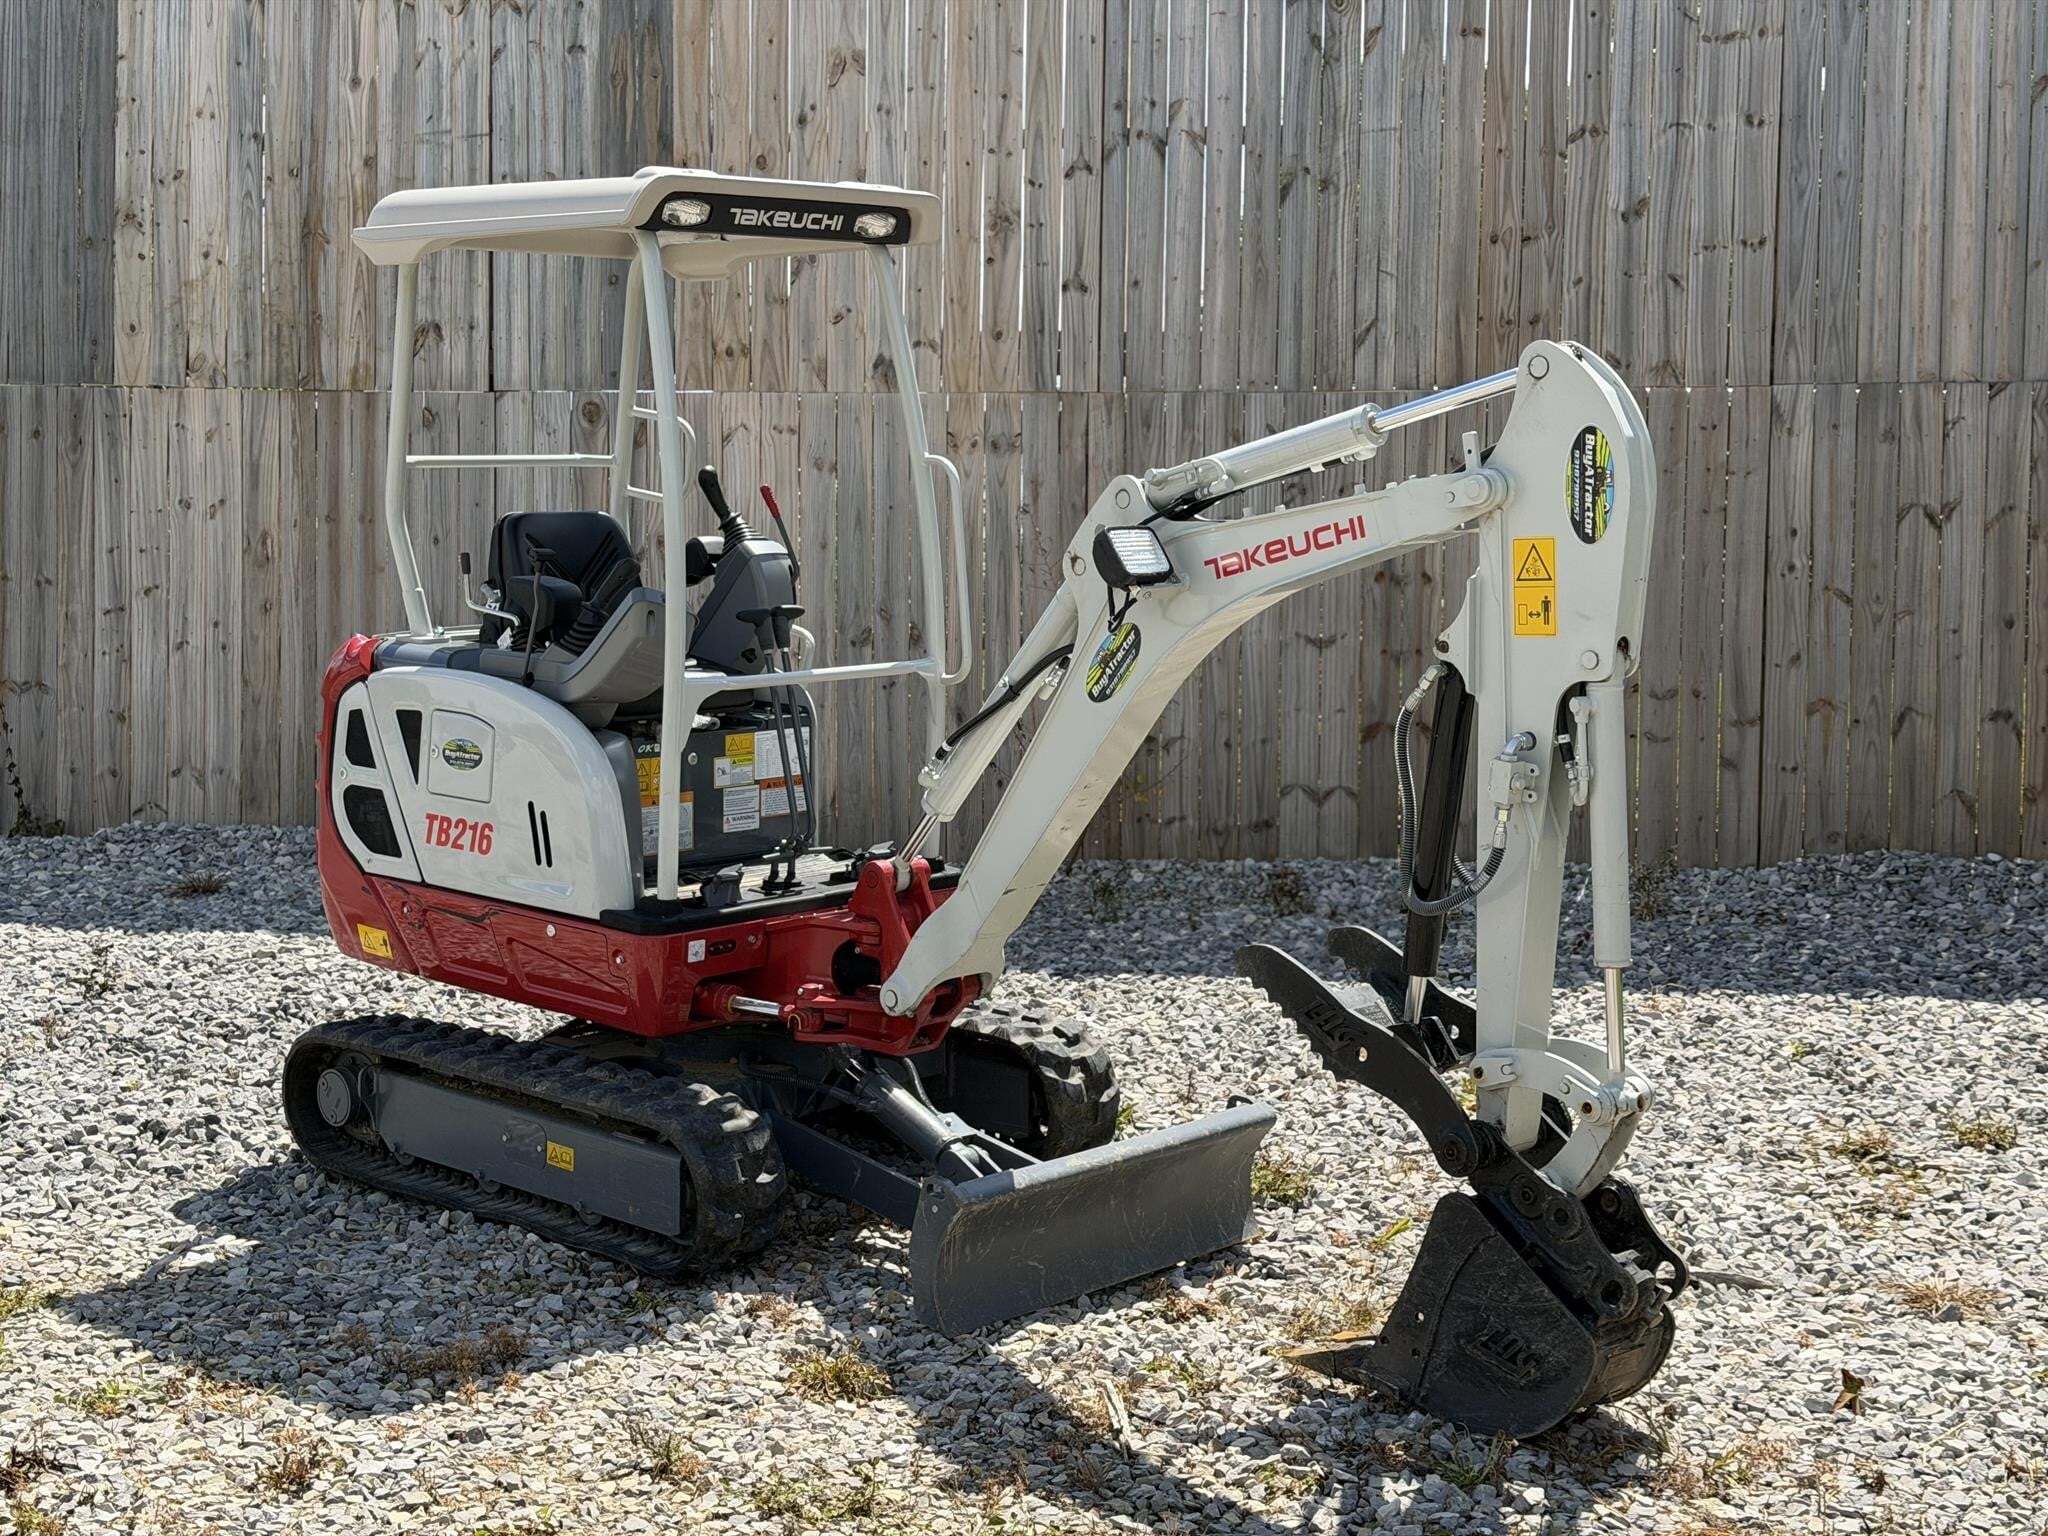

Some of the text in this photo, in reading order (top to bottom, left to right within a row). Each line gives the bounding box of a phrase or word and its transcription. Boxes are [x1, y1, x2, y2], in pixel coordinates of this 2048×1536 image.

[730, 207, 844, 231] TAKEUCHI
[1583, 434, 1595, 537] BuyATractor
[1204, 515, 1366, 580] TAKEUCHI
[1091, 630, 1136, 698] BuyATractor
[425, 812, 494, 856] TB216
